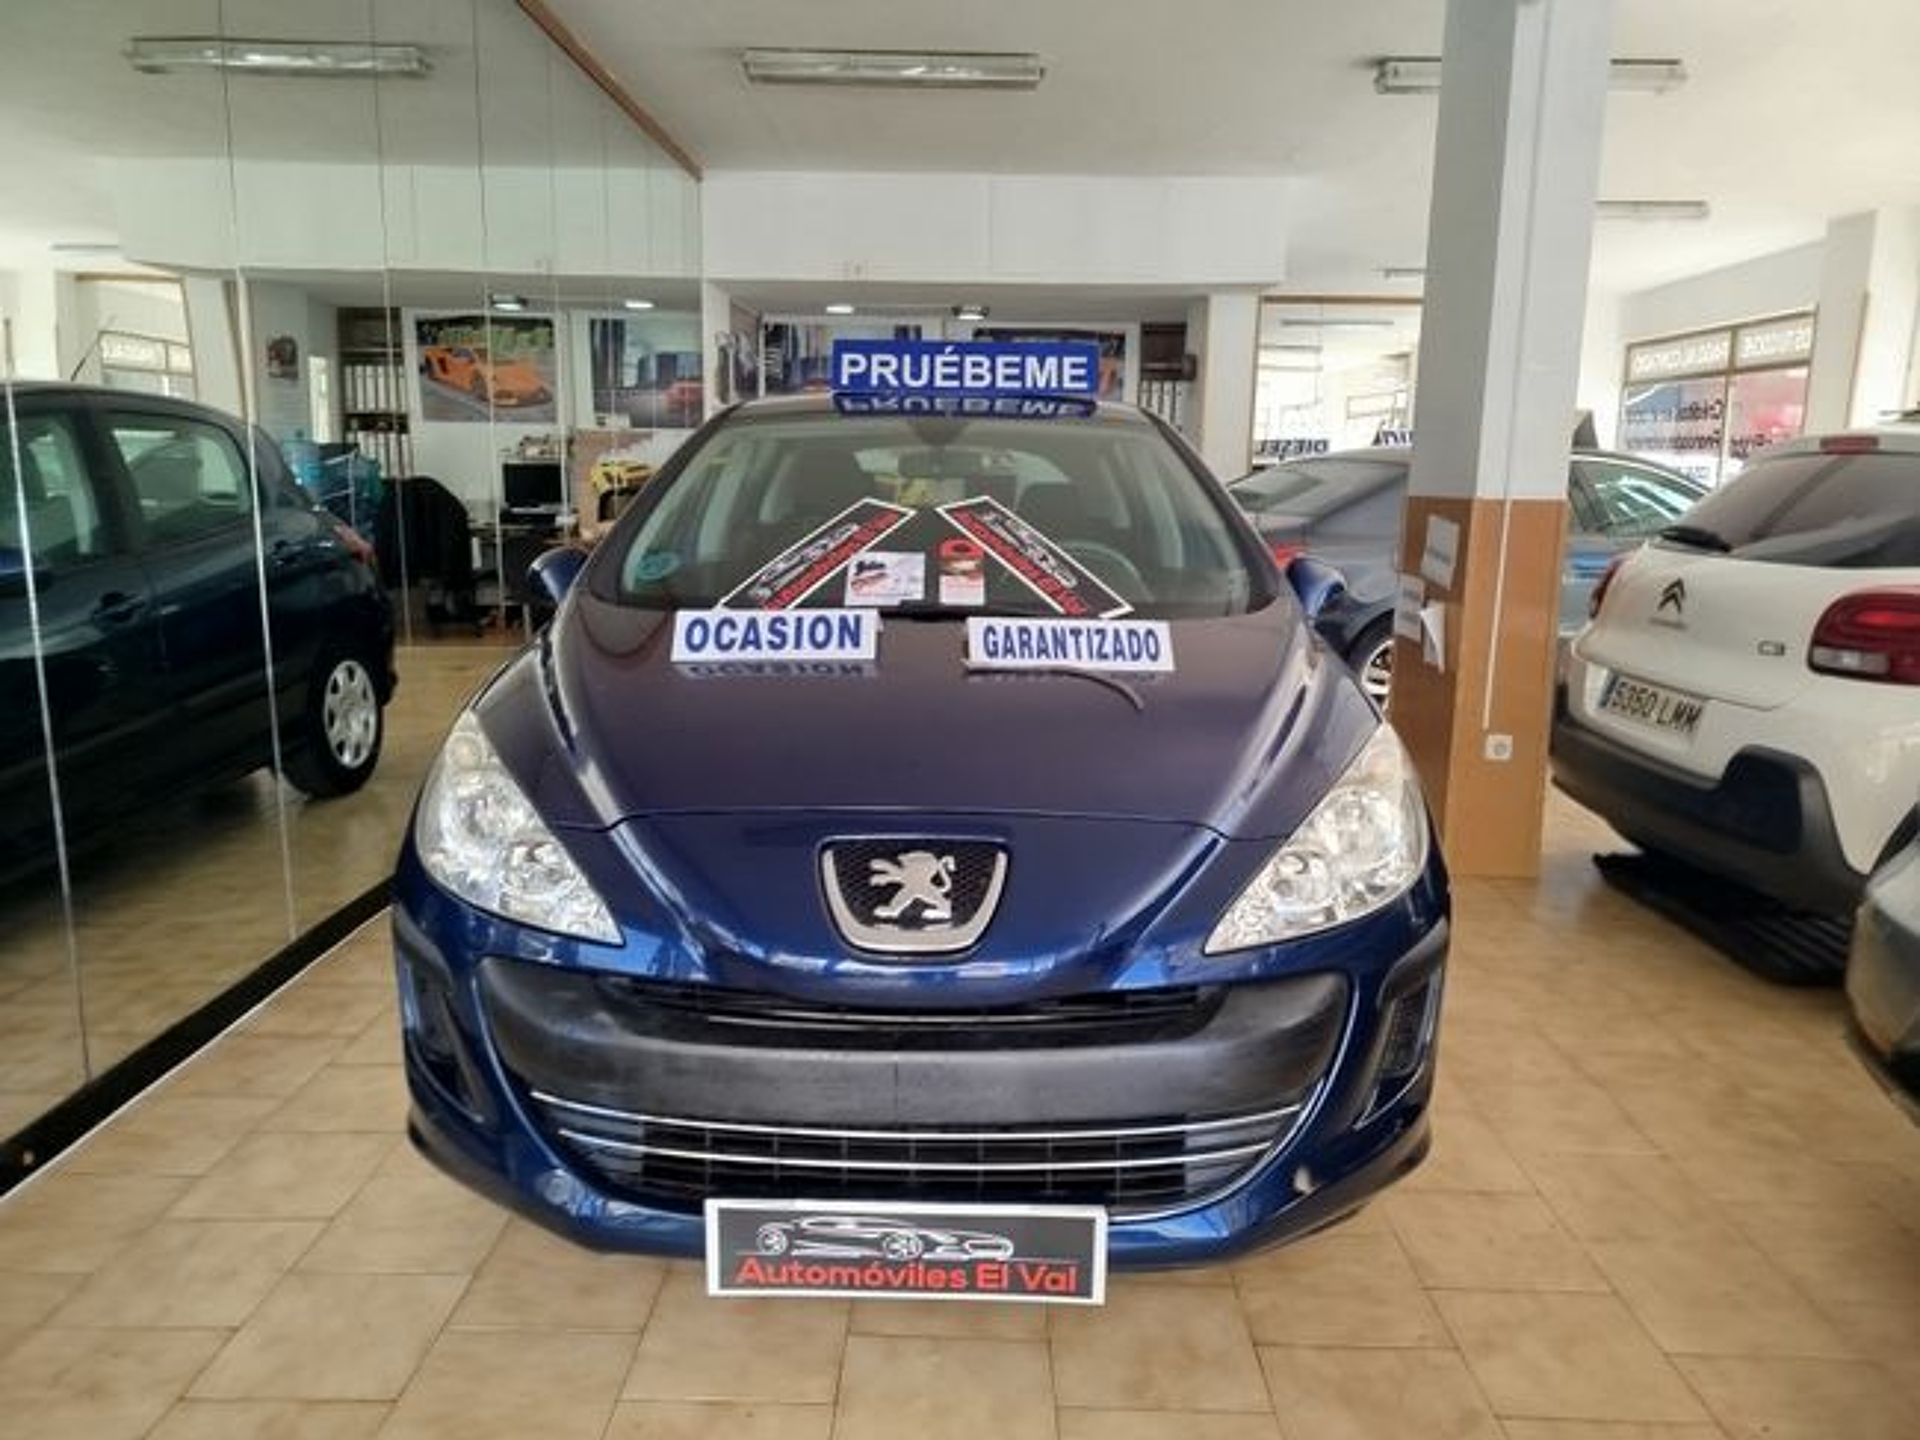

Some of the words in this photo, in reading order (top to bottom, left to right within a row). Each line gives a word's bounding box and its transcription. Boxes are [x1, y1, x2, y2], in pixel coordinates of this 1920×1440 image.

[840, 345, 1088, 389] PRUÉBEME
[684, 614, 862, 651] OCASION
[982, 625, 1160, 662] GARANTIZADO
[1757, 640, 1786, 656] C3
[735, 1256, 969, 1288] Automóviles
[976, 1263, 1008, 1289] El
[1016, 1264, 1077, 1292] Val
